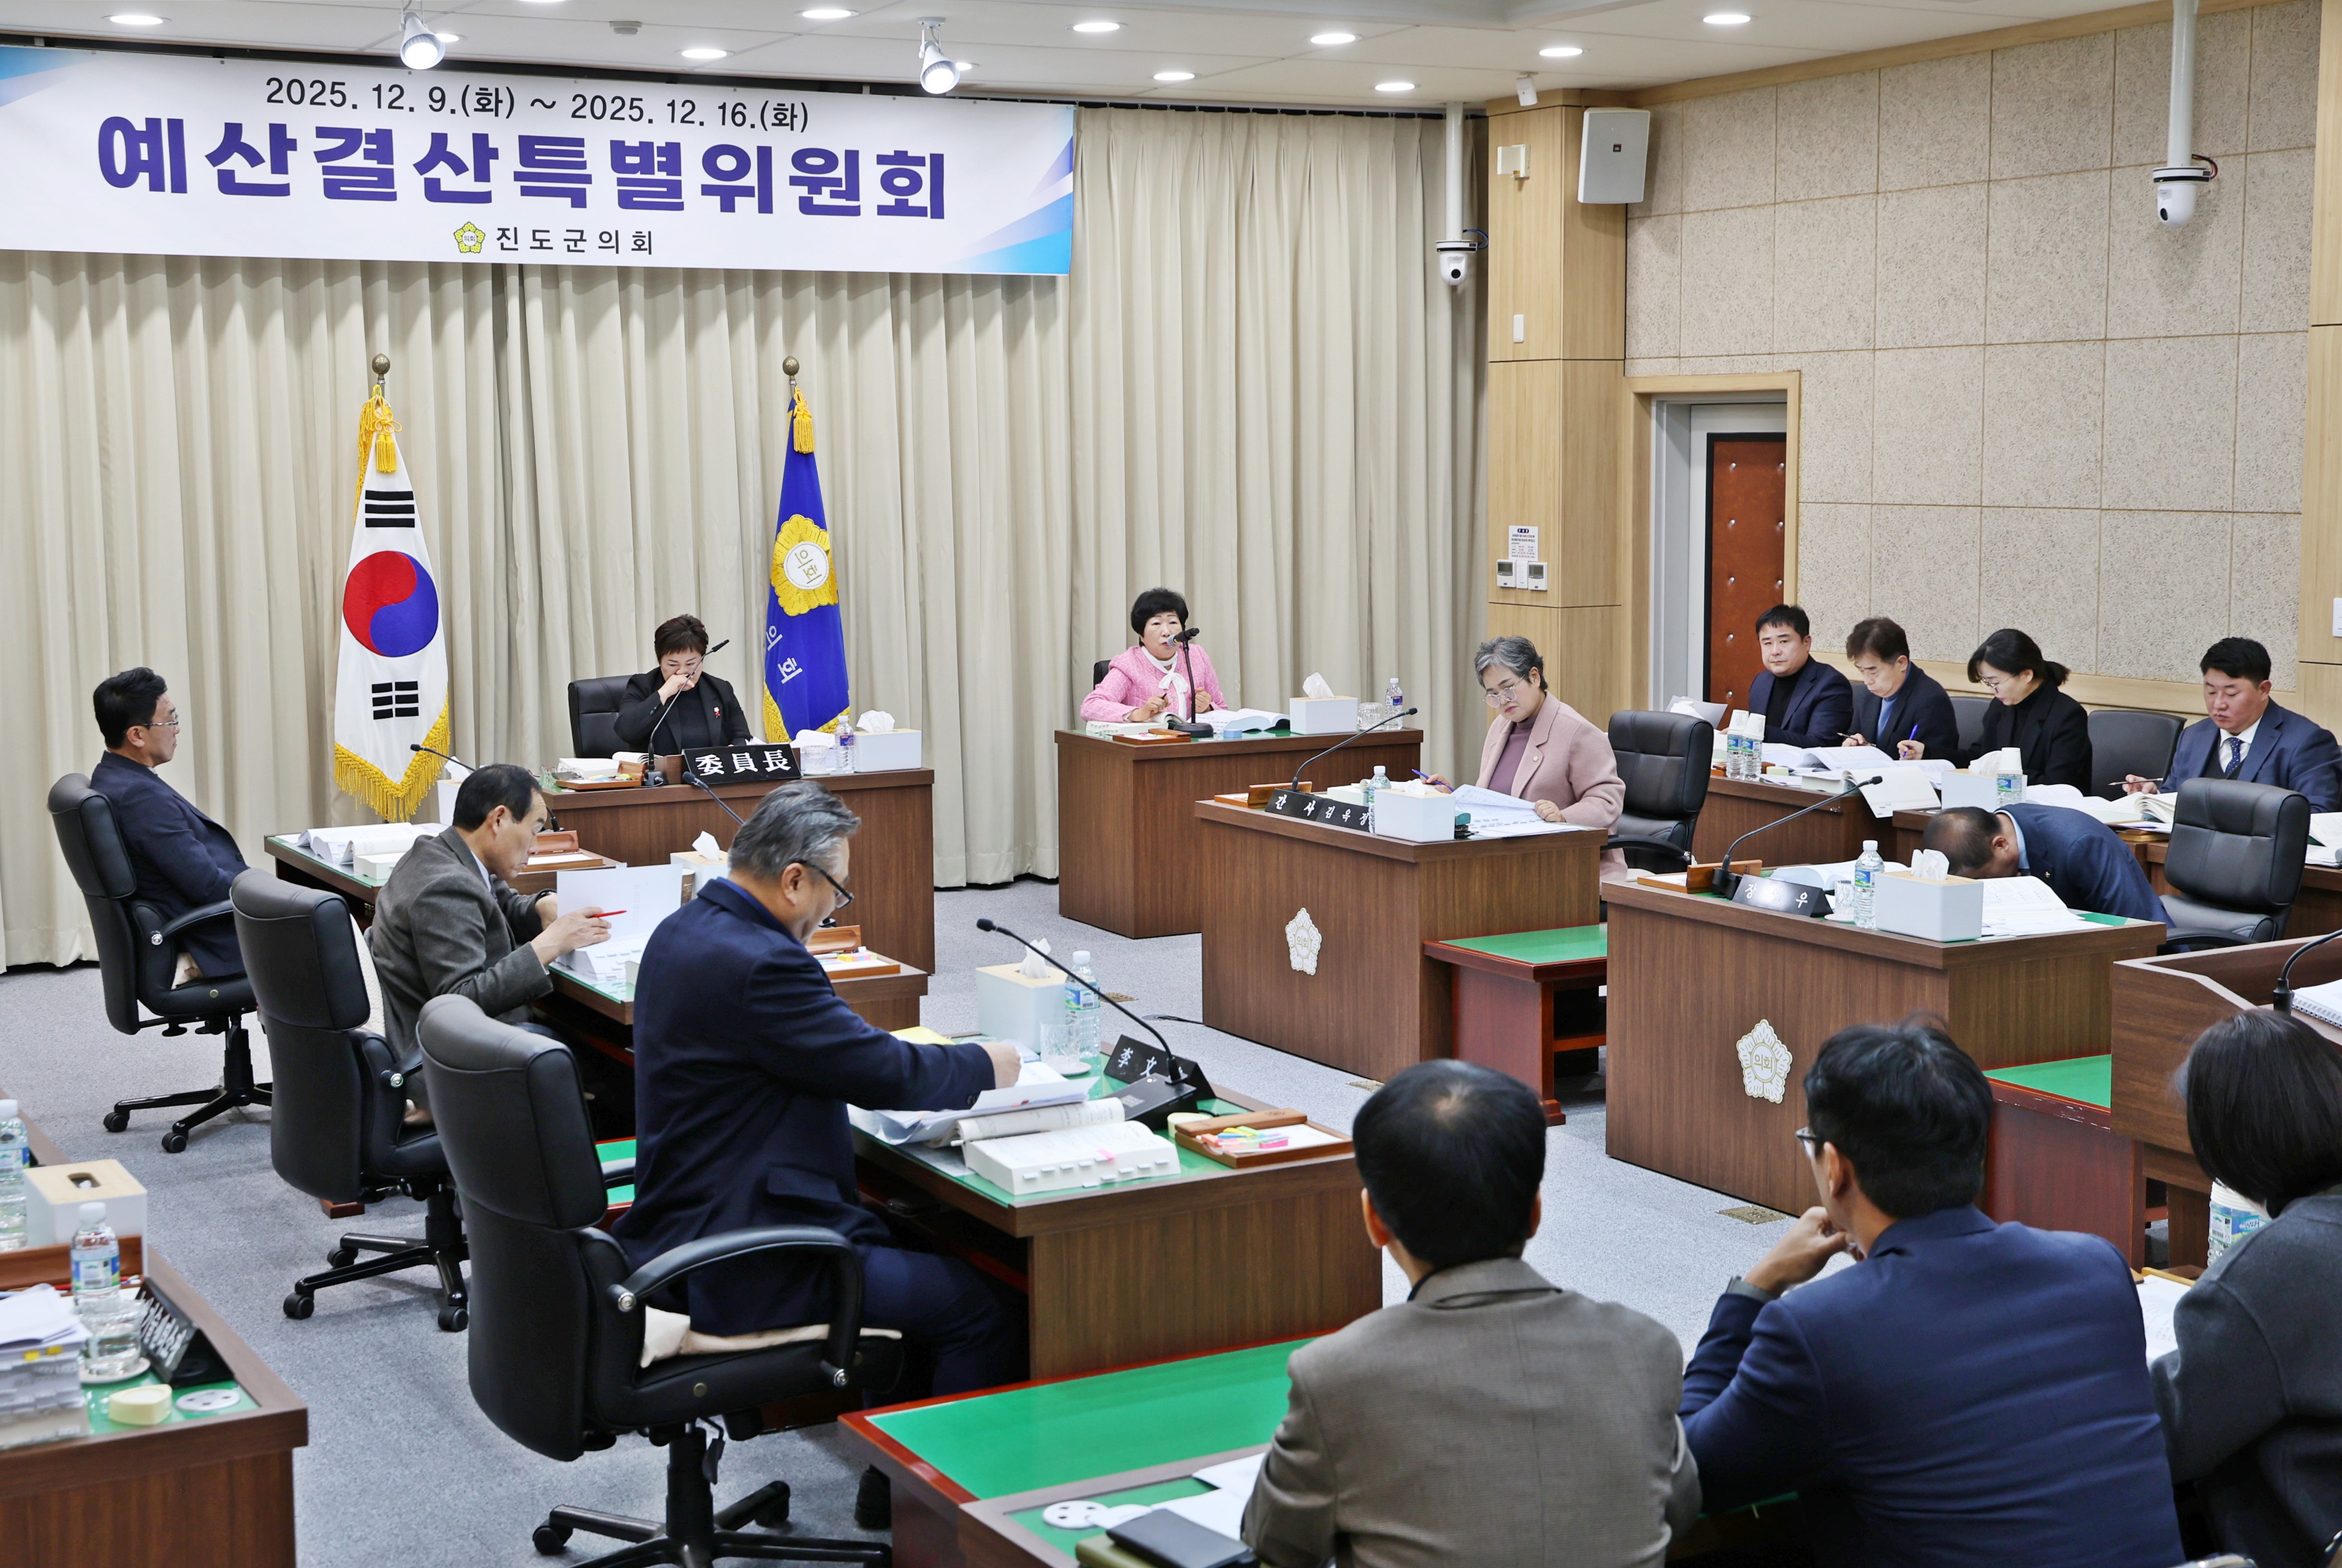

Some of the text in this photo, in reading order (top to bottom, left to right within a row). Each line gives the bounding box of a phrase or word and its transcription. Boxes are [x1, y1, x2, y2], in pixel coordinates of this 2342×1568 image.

[266, 77, 358, 109] 2025.
[372, 83, 415, 112] 12.
[429, 84, 515, 119] 9.(화)
[571, 94, 653, 124] 2025.
[667, 99, 704, 127] 12.
[718, 100, 808, 133] 16.(화)
[98, 116, 945, 220] 예산결산특별위원회
[496, 227, 652, 255] 진도군의회
[794, 548, 822, 584] 의회
[695, 749, 791, 776] 委員長
[1296, 935, 1310, 951] 의회
[1753, 1054, 1773, 1073] 의회
